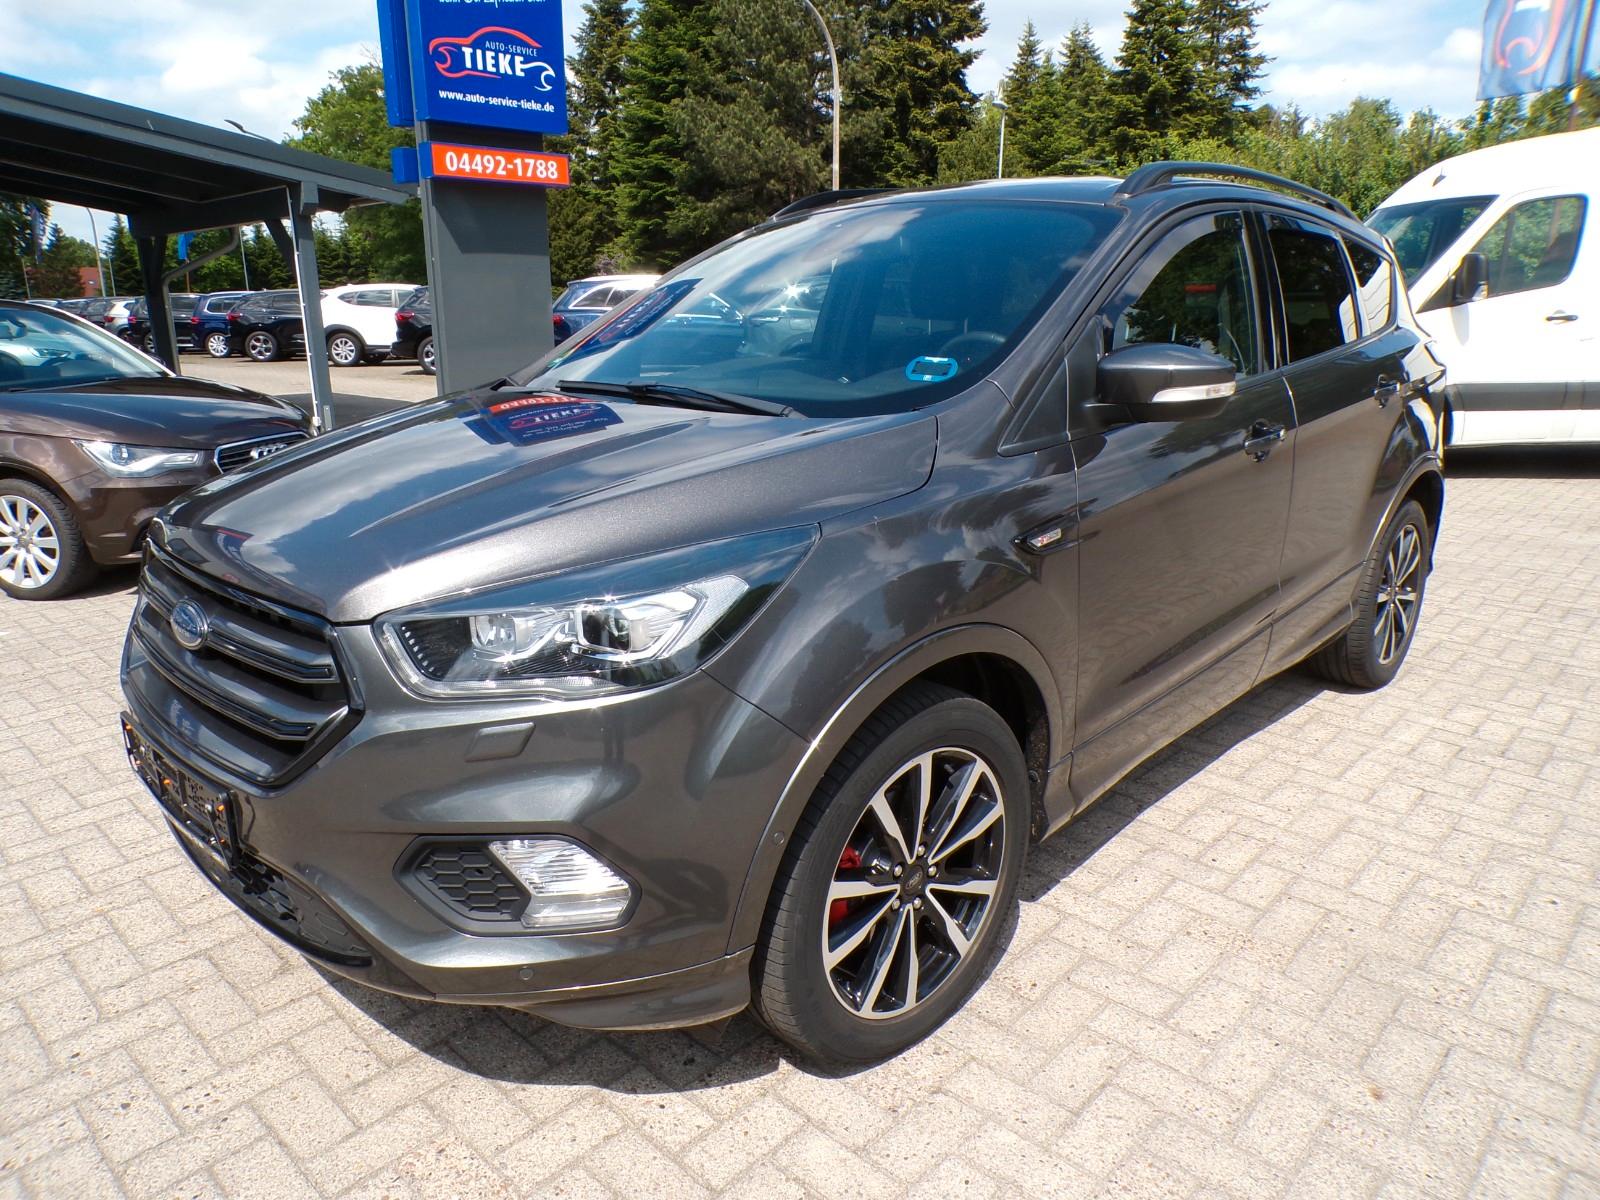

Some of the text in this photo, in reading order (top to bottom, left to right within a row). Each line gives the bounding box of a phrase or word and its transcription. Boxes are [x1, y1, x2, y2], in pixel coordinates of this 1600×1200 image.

[485, 40, 538, 57] AUTO-SERVICE
[462, 46, 525, 77] TIEKE
[438, 90, 555, 113] www.auto-service-tieke.de
[445, 151, 558, 179] 04492-1788
